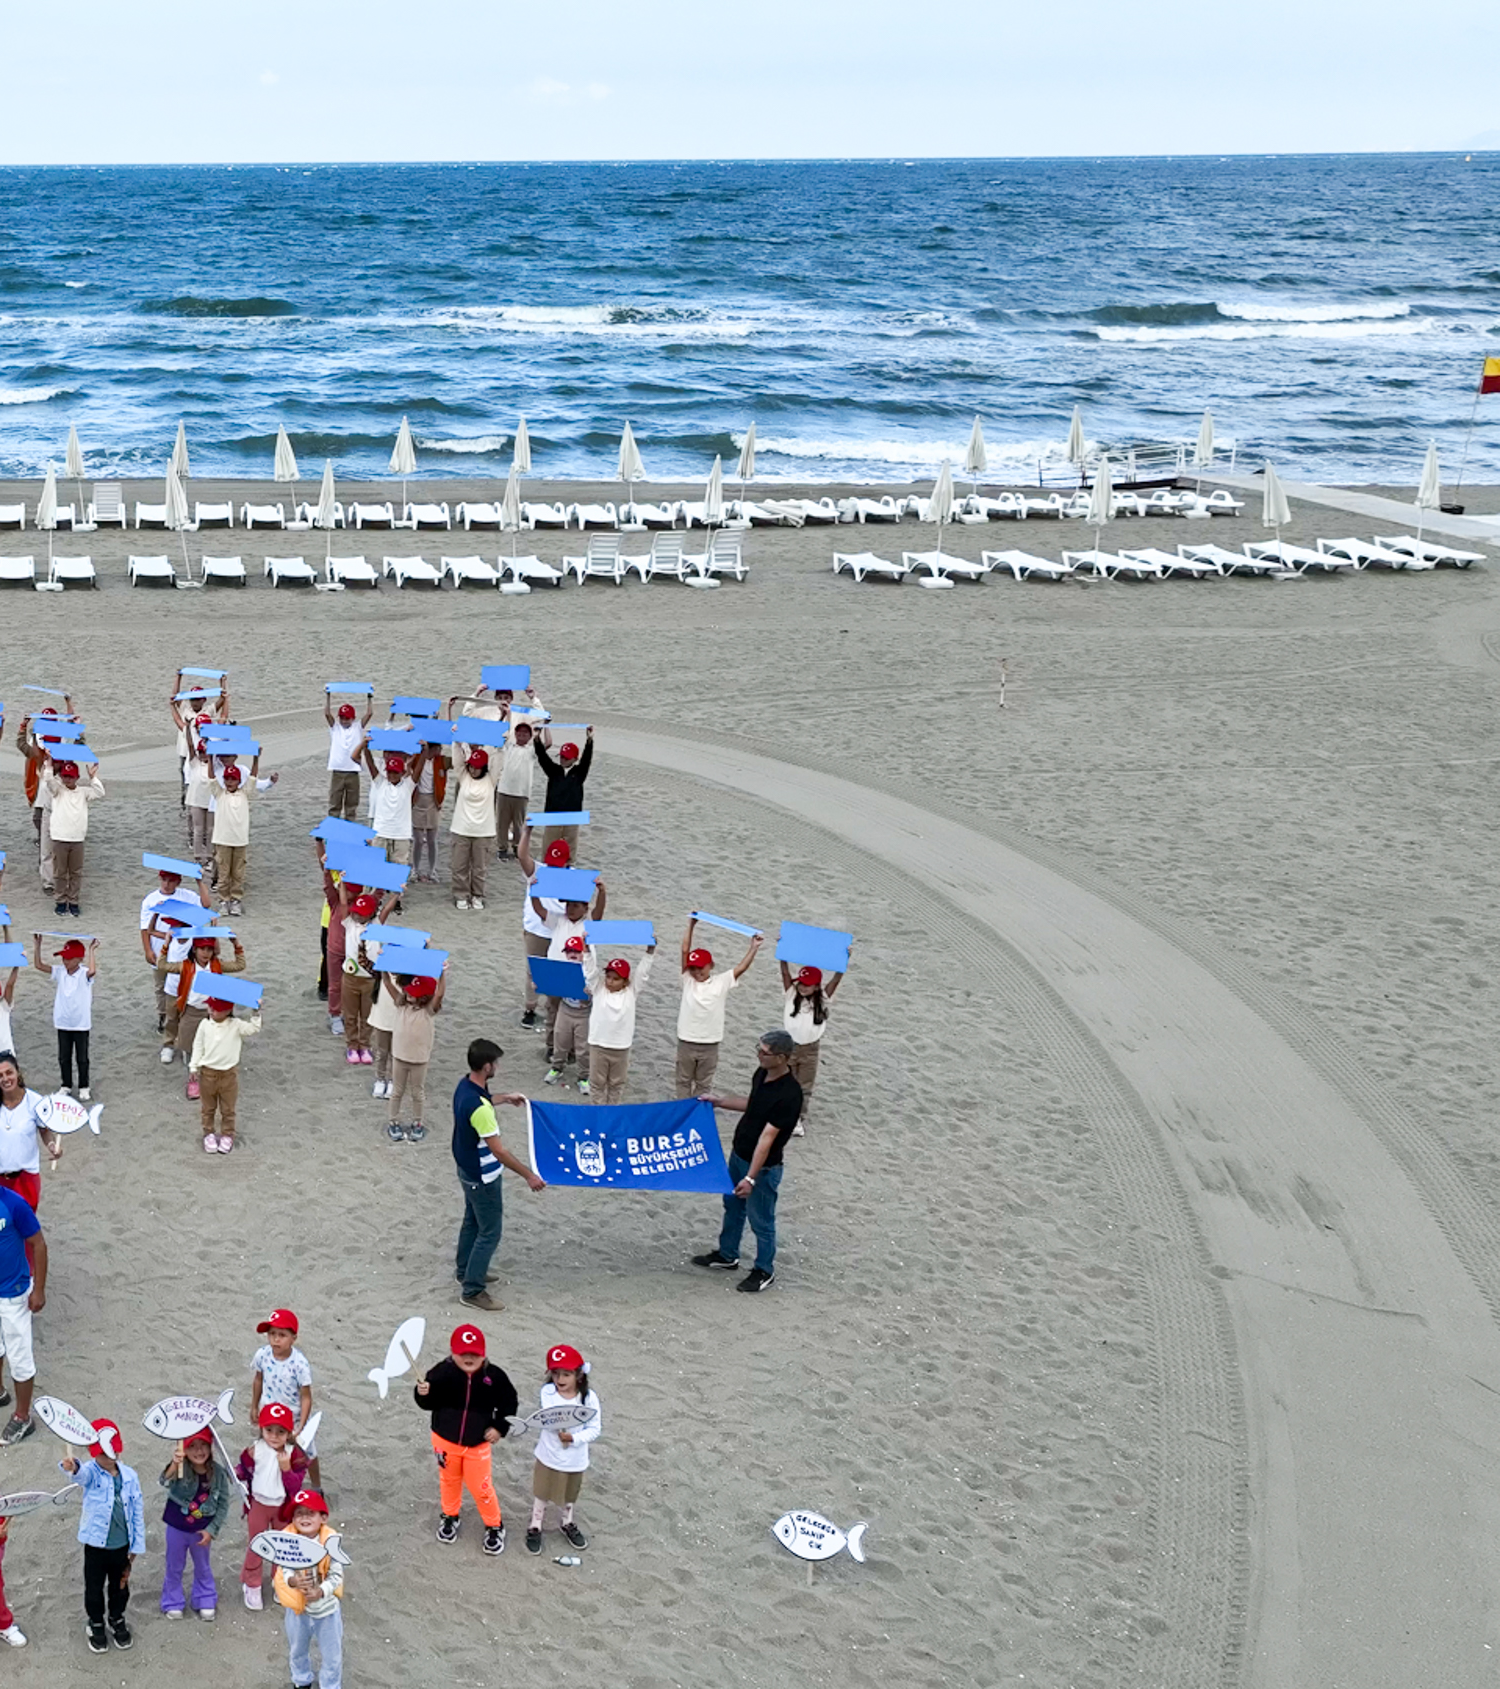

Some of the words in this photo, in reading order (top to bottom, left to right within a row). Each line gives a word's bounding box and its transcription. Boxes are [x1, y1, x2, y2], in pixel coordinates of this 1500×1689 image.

[626, 1128, 702, 1154] BURSA
[628, 1142, 706, 1166] BÜYÜKŞEHİR
[631, 1150, 710, 1176] BELEDİYESİ
